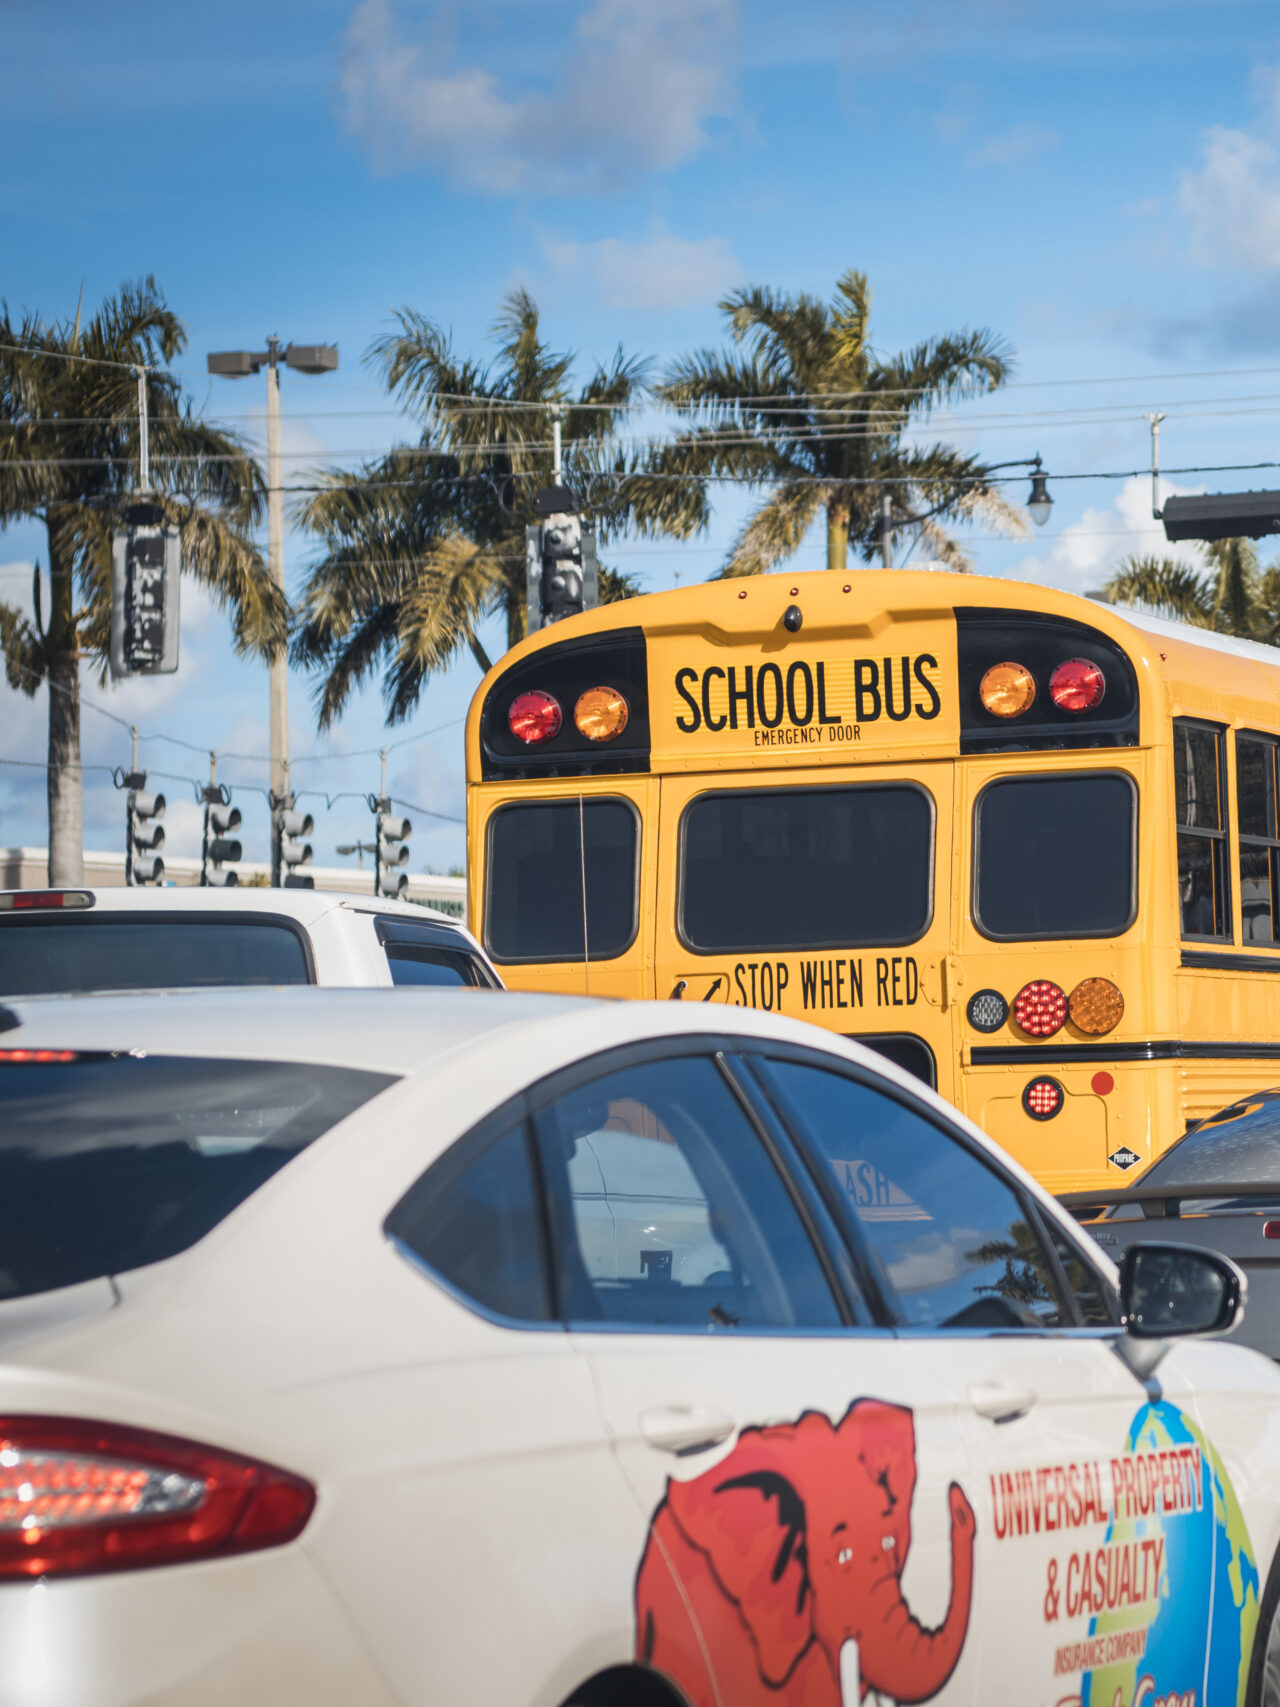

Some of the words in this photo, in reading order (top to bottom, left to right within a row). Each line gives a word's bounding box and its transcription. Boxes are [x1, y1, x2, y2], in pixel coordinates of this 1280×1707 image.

[675, 661, 842, 734] SCHOOL
[854, 654, 941, 723] BUS
[754, 727, 823, 746] EMERGENCY
[829, 725, 861, 742] DOOR
[734, 961, 789, 1012] STOP
[800, 959, 864, 1010] WHEN
[876, 956, 919, 1007] RED
[1113, 1153, 1135, 1163] PROPANE
[990, 1461, 1108, 1540] UNIVERSAL
[1110, 1447, 1203, 1519] PROPERTY
[1044, 1558, 1060, 1622] &
[1066, 1538, 1164, 1618] CASUALTY
[1054, 1638, 1105, 1676] INSURANCE
[1105, 1628, 1147, 1662] COMPANY
